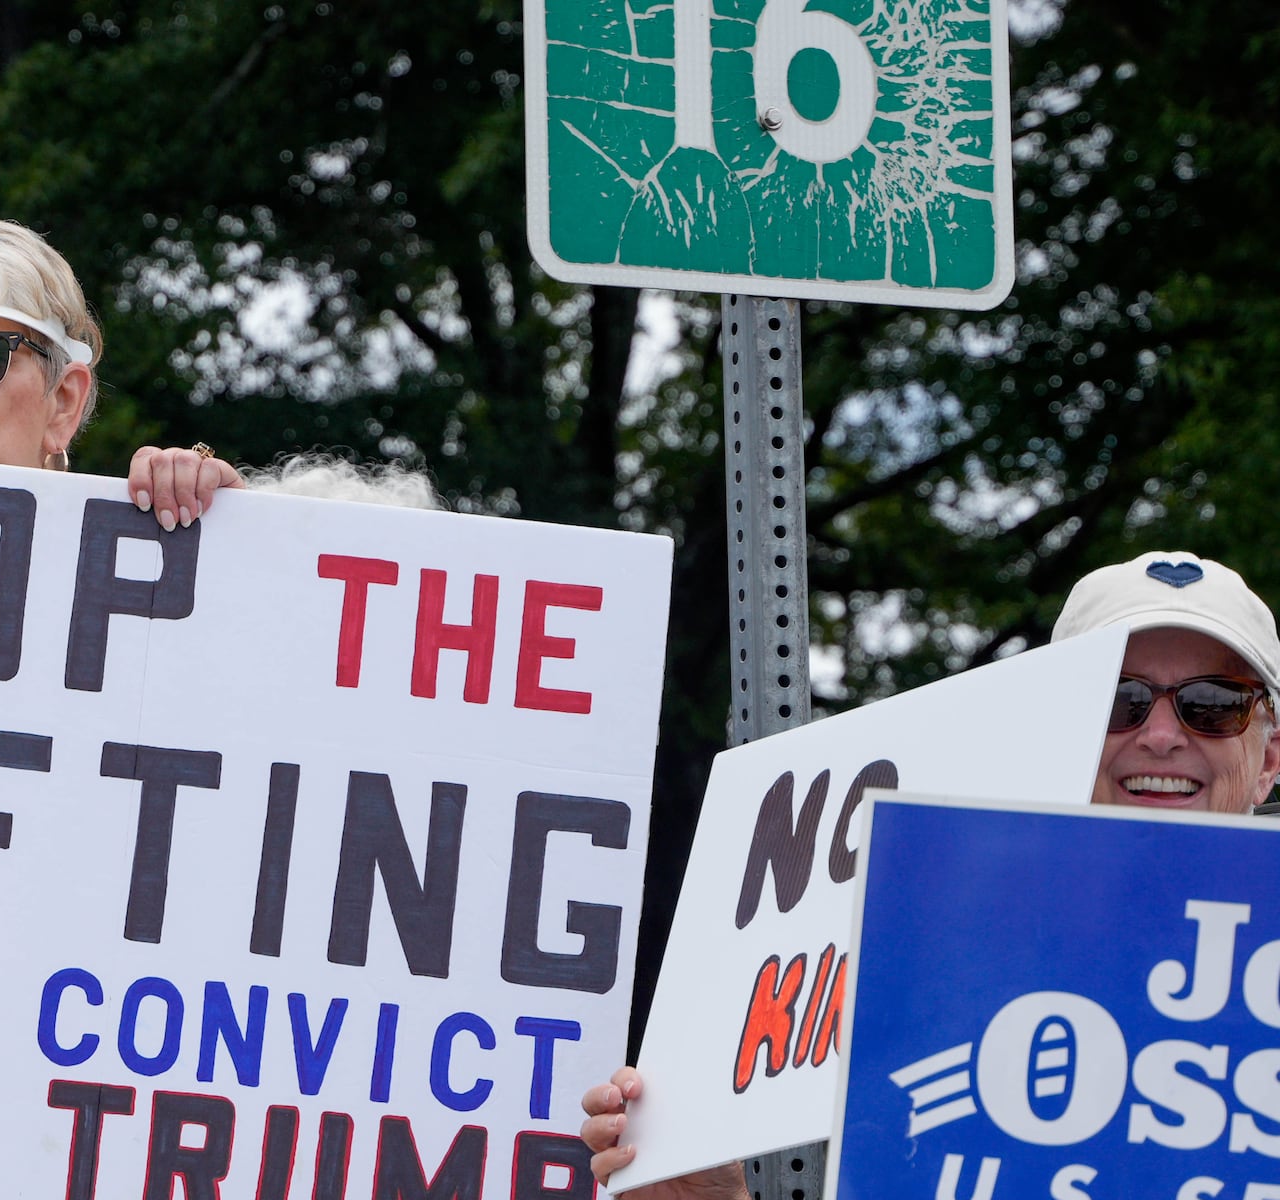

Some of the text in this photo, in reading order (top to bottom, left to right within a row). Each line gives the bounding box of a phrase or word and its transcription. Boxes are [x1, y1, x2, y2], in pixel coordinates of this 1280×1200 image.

[674, 0, 877, 164] 16
[317, 554, 604, 714] THE
[38, 967, 581, 1119] CONVICT
